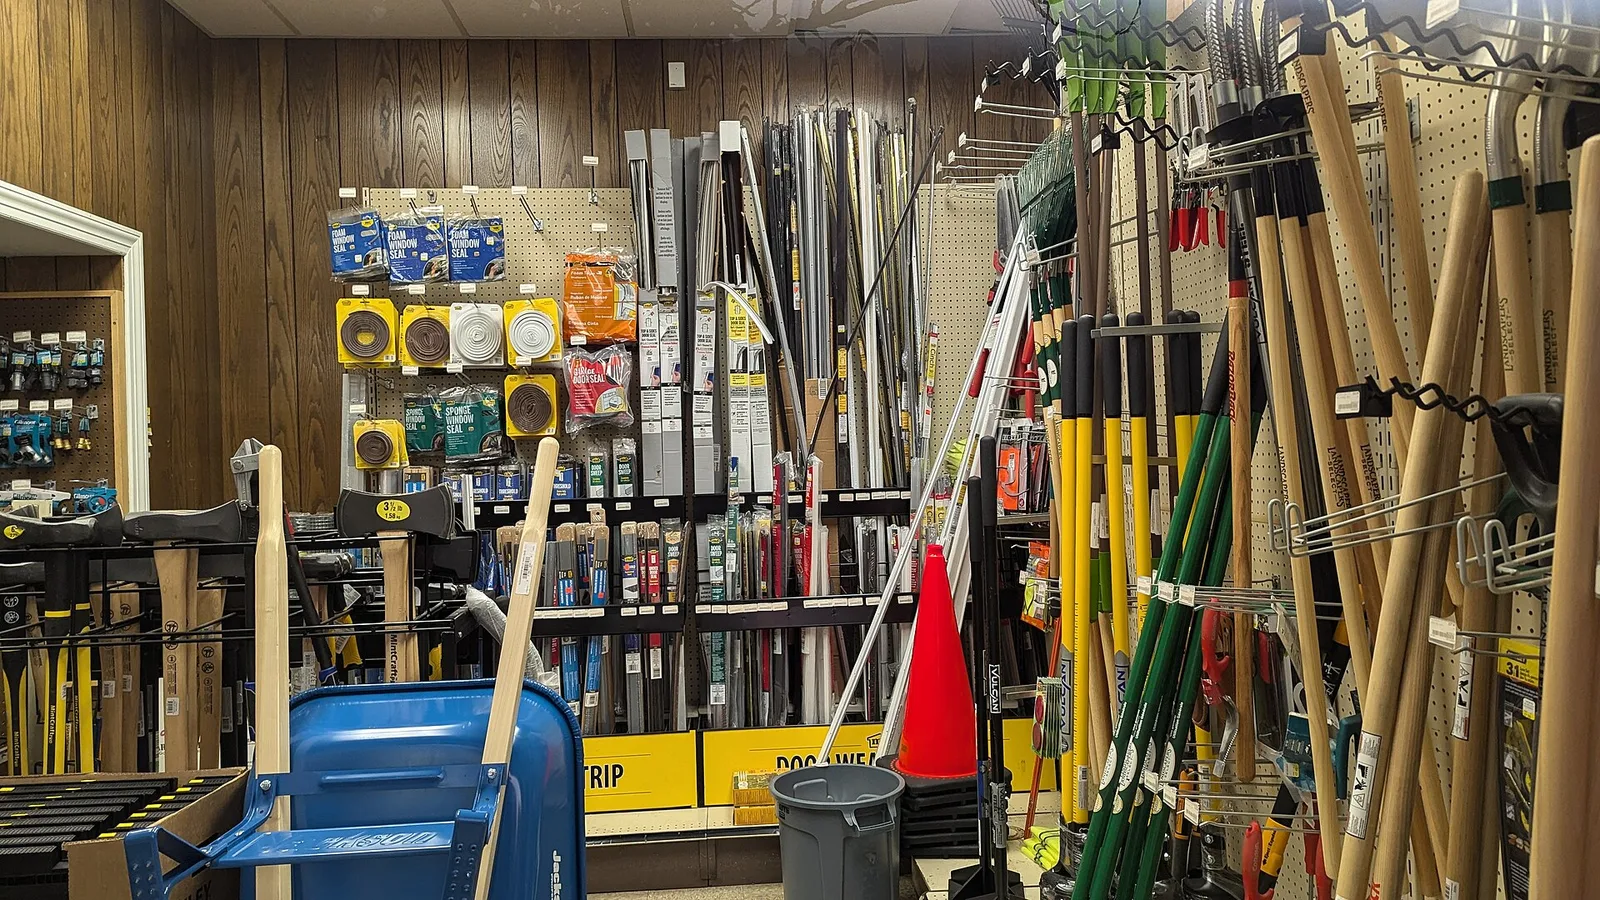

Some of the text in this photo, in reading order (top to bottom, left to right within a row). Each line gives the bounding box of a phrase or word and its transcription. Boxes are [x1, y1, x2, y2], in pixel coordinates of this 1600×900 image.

[1292, 58, 1315, 115] NDSCAPERS
[331, 228, 346, 238] FOAM
[388, 230, 407, 241] FOAM
[451, 229, 470, 240] FOAM
[332, 234, 355, 245] WINDOW
[388, 239, 418, 250] WINDOW
[451, 239, 480, 248] WINDOW
[333, 244, 347, 253] SEAL
[451, 248, 469, 258] SEAL
[389, 249, 407, 260] SEAL
[1499, 297, 1513, 372] LANDSCAPERS
[1543, 309, 1557, 384] LANDSCAPERS
[590, 373, 605, 383] SEAL
[405, 407, 424, 416] SPONGE
[445, 405, 471, 416] SPONGE
[405, 415, 426, 423] WINDOW
[445, 414, 474, 425] WINDOW
[405, 423, 418, 431] SEAL
[446, 425, 463, 434] SEAL
[1327, 446, 1346, 508] LANDSCAPERS
[383, 501, 389, 511] 3
[390, 634, 398, 677] MintCraft
[1506, 661, 1519, 678] 31
[991, 669, 999, 712] VULCAN
